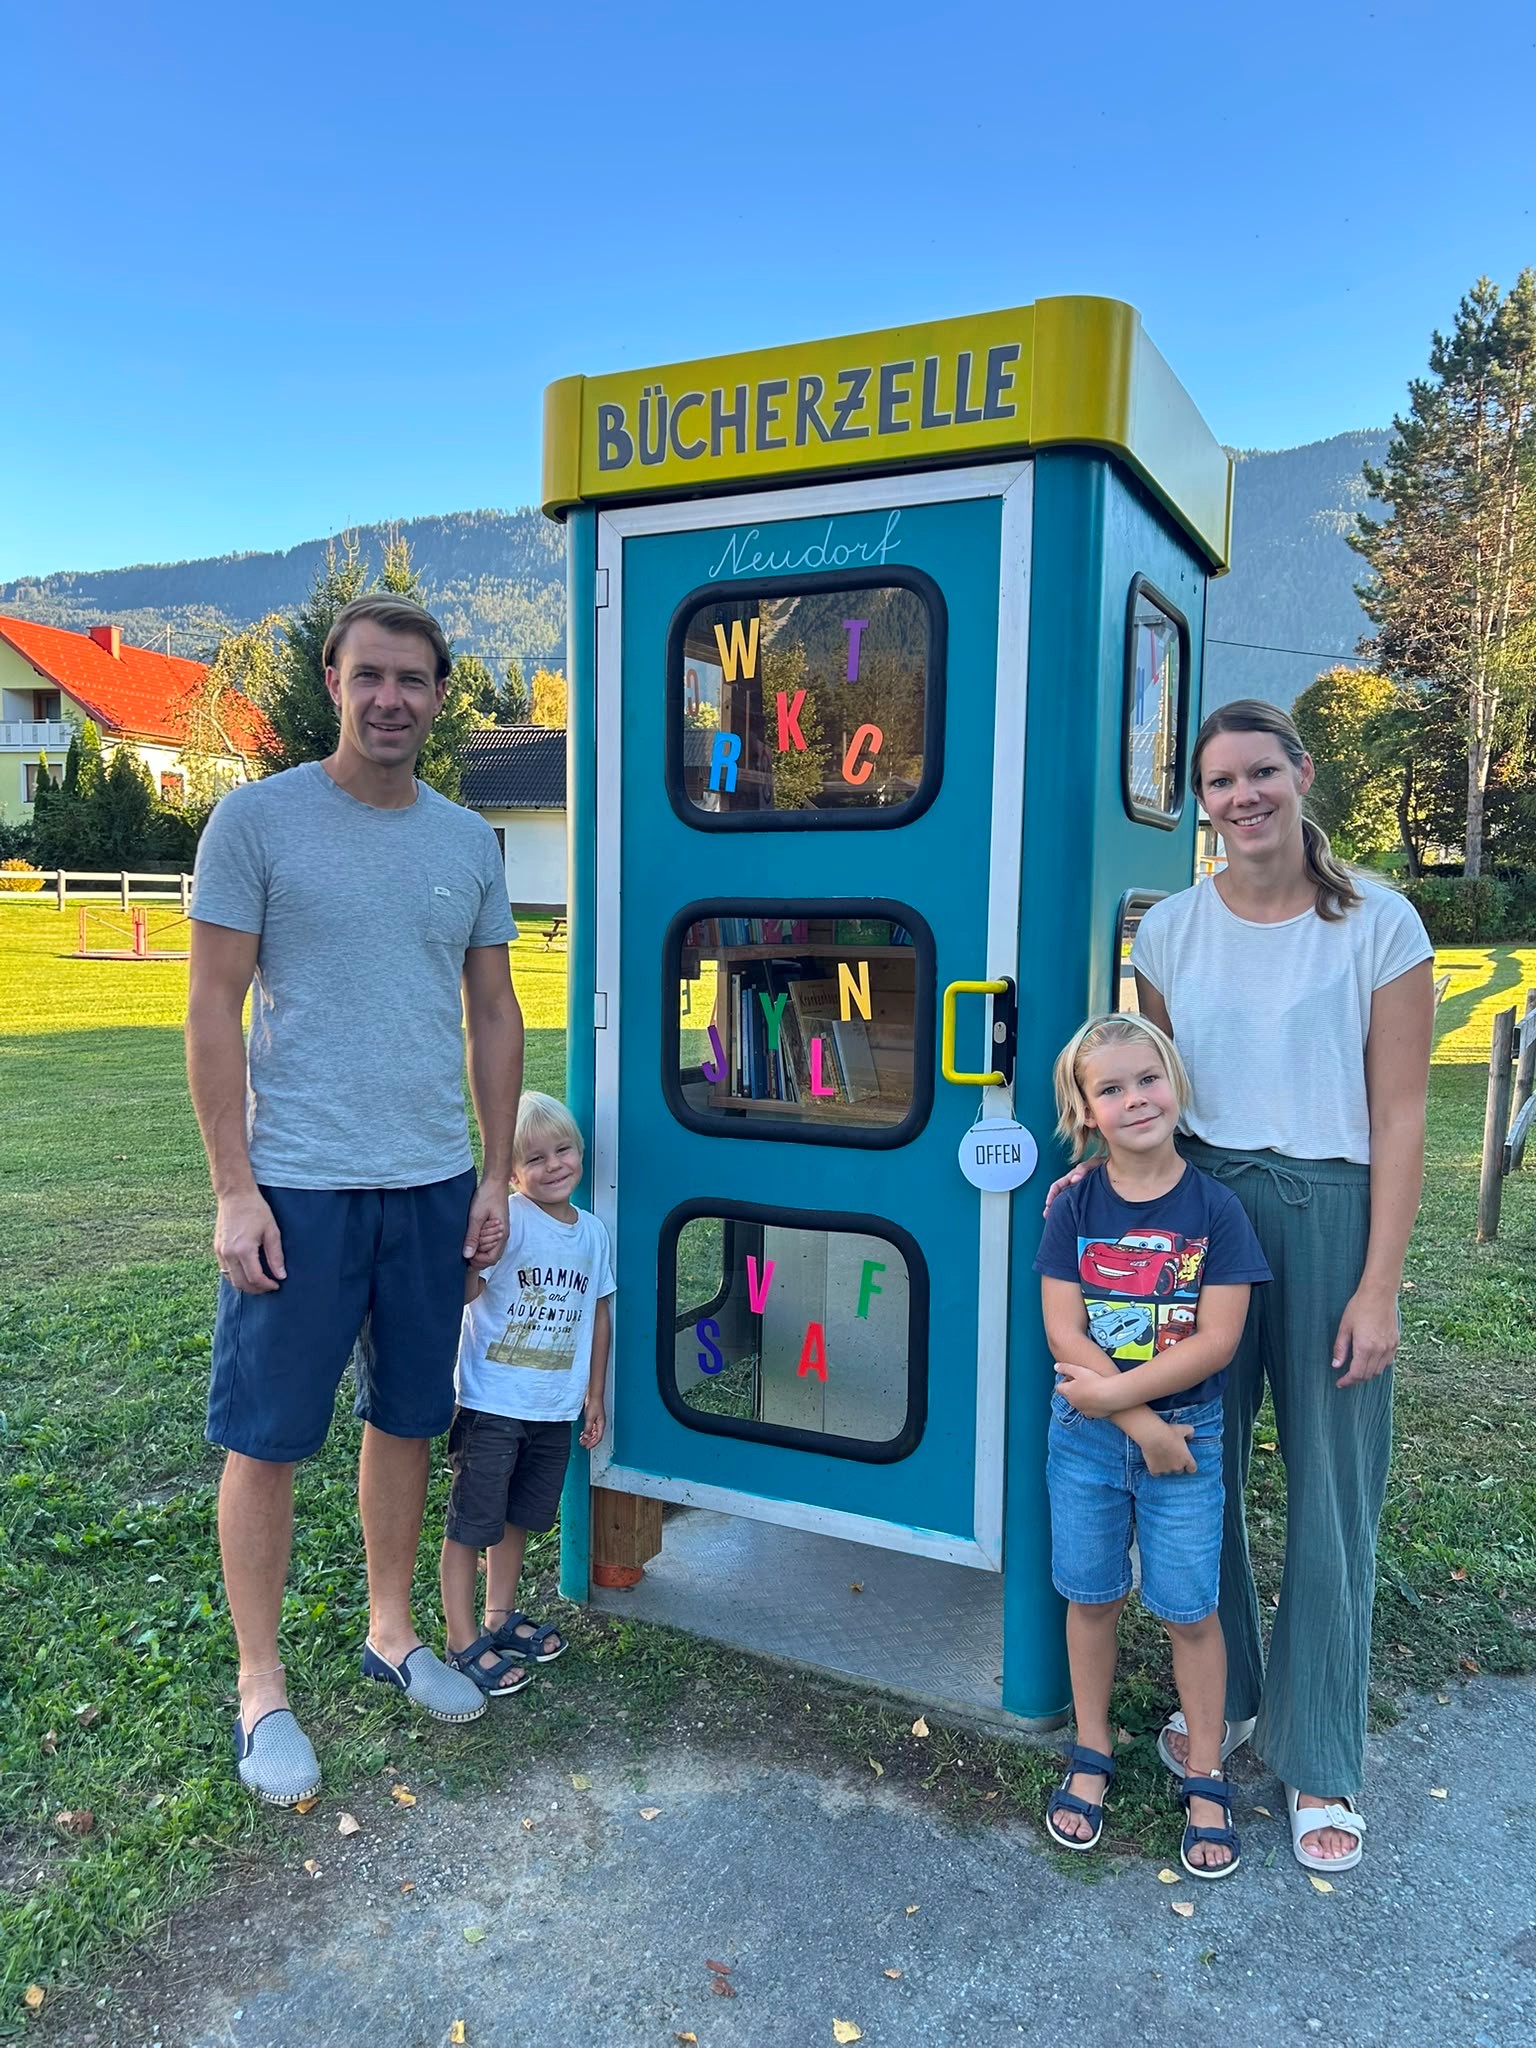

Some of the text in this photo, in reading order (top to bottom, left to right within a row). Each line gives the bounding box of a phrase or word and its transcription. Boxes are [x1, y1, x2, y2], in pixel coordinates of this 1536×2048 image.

[598, 344, 1021, 470] BÜCHERZELLE
[708, 510, 902, 578] Neudorf
[714, 617, 760, 682] W
[842, 619, 869, 682] T
[775, 690, 808, 751] K
[709, 731, 742, 793] R
[841, 723, 884, 785] C
[837, 961, 872, 1021] N
[759, 992, 788, 1050] Y
[701, 1025, 727, 1082] J
[811, 1037, 834, 1096] L
[975, 1143, 1021, 1165] OFFEN
[517, 1267, 590, 1295] ROAMING
[548, 1290, 570, 1303] and
[746, 1255, 776, 1314] V
[857, 1259, 886, 1318] F
[506, 1302, 583, 1322] ADVENTURE
[695, 1318, 723, 1375] S
[796, 1321, 829, 1382] A
